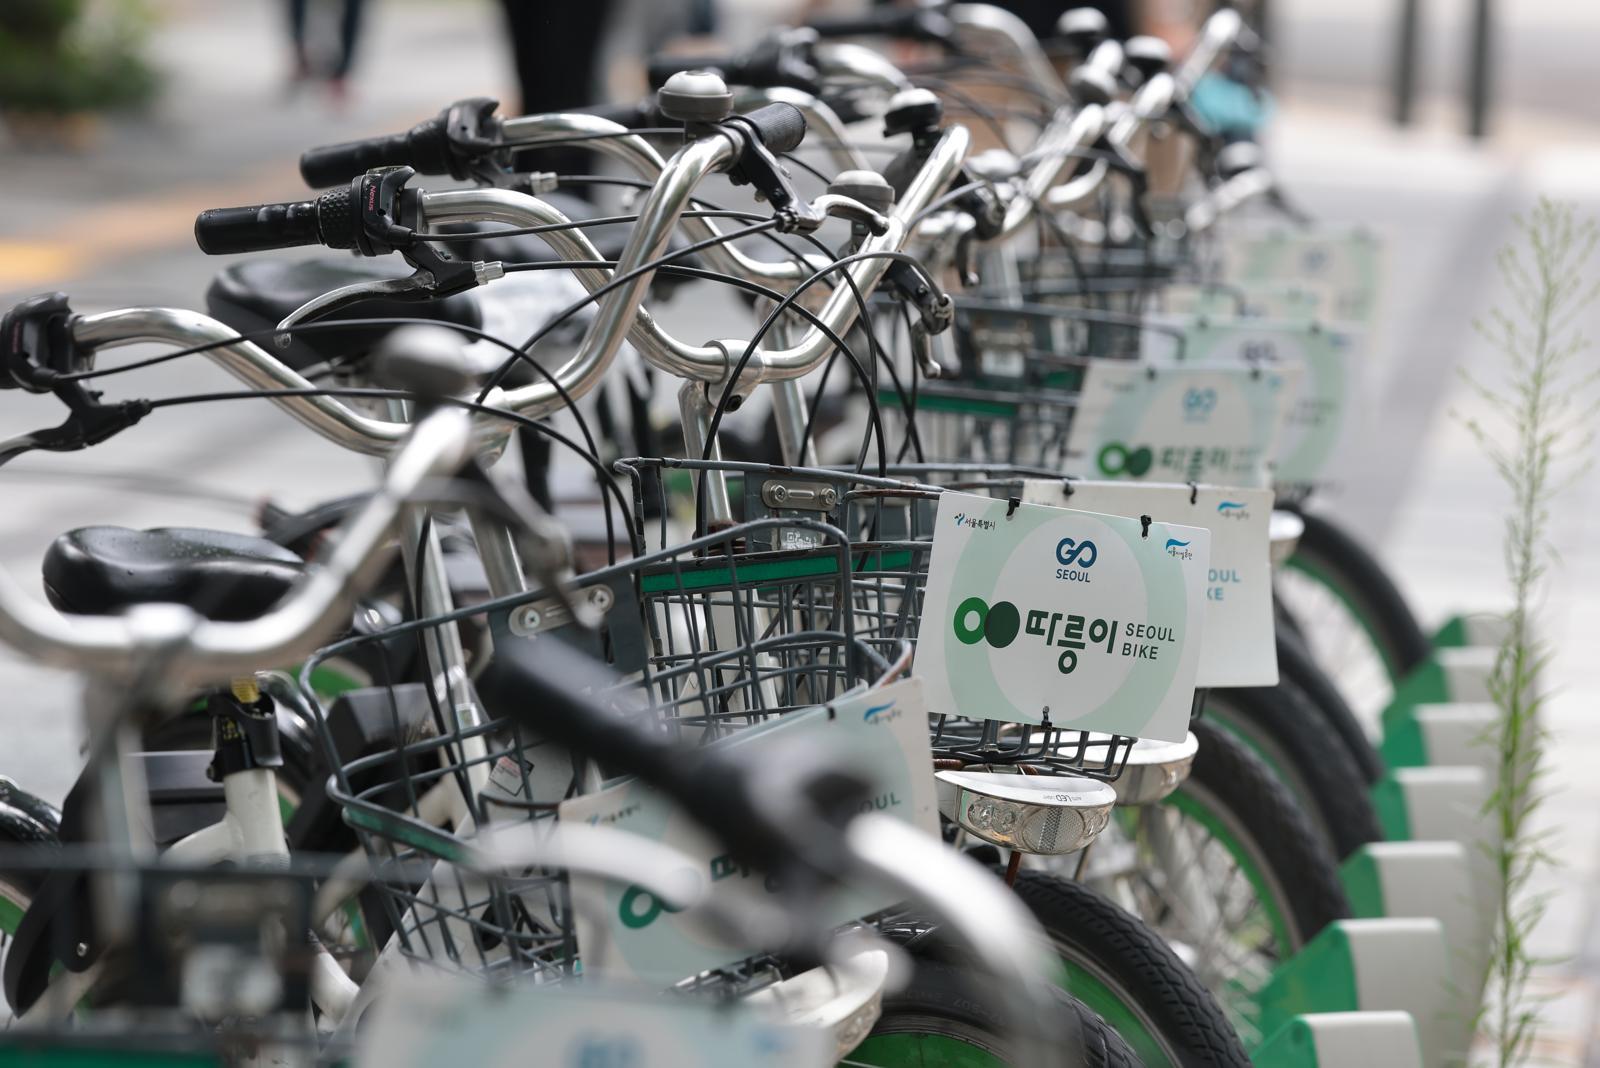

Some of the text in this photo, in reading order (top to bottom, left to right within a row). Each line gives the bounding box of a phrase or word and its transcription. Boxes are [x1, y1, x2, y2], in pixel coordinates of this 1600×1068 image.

[964, 517, 996, 531] 서울특별시
[1056, 537, 1097, 569] GO
[1055, 568, 1091, 583] SEOUL
[1207, 567, 1241, 583] OUL
[1125, 622, 1176, 642] SEOUL
[1025, 609, 1119, 675] 따릉이
[1121, 642, 1159, 660] BIKE
